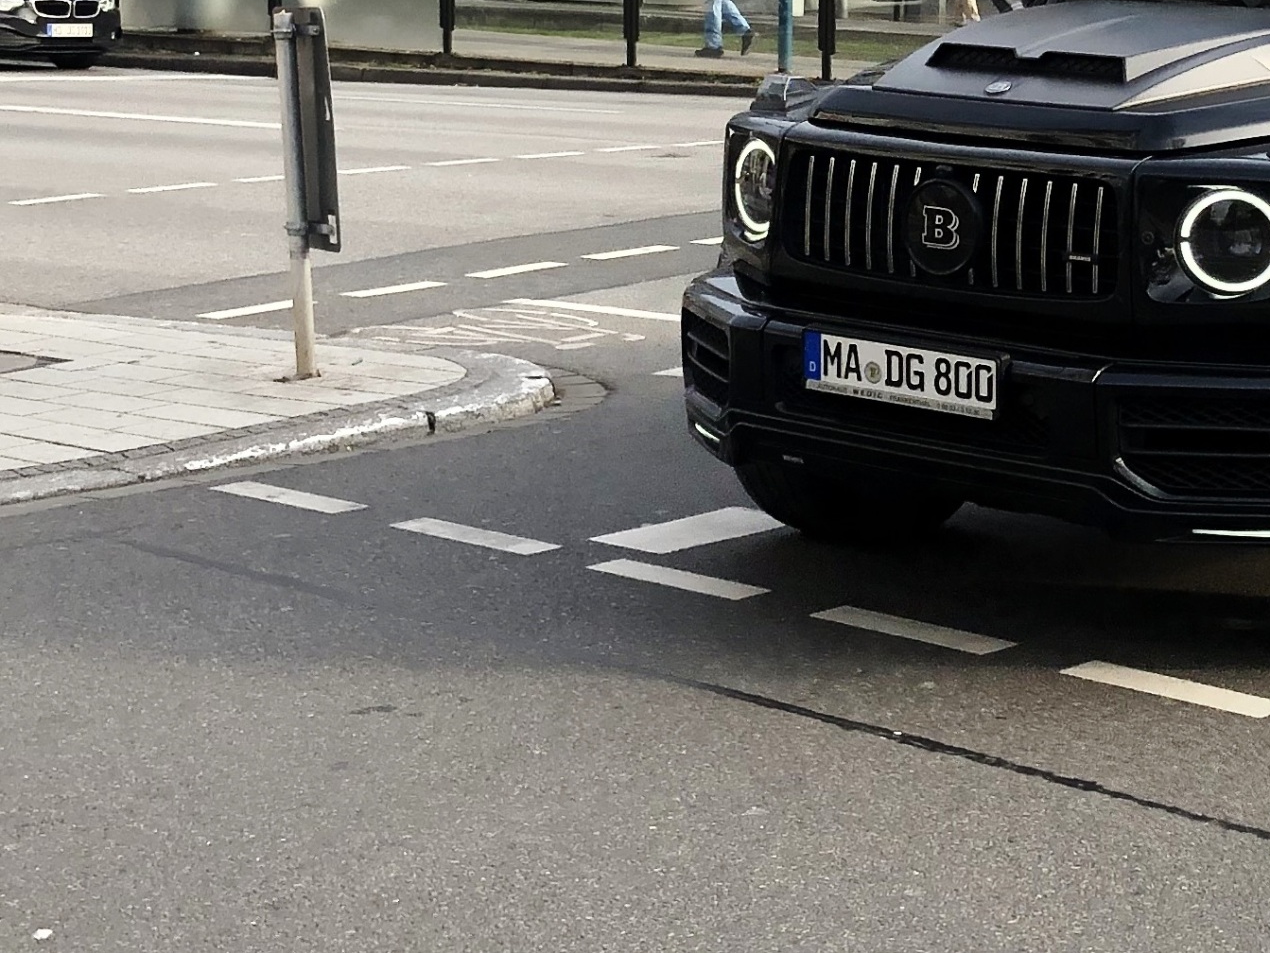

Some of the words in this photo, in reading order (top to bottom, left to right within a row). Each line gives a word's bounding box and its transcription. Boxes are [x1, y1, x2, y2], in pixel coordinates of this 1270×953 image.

[921, 204, 960, 250] B
[822, 338, 863, 382] MA
[884, 348, 925, 393] DG
[933, 357, 995, 404] 800
